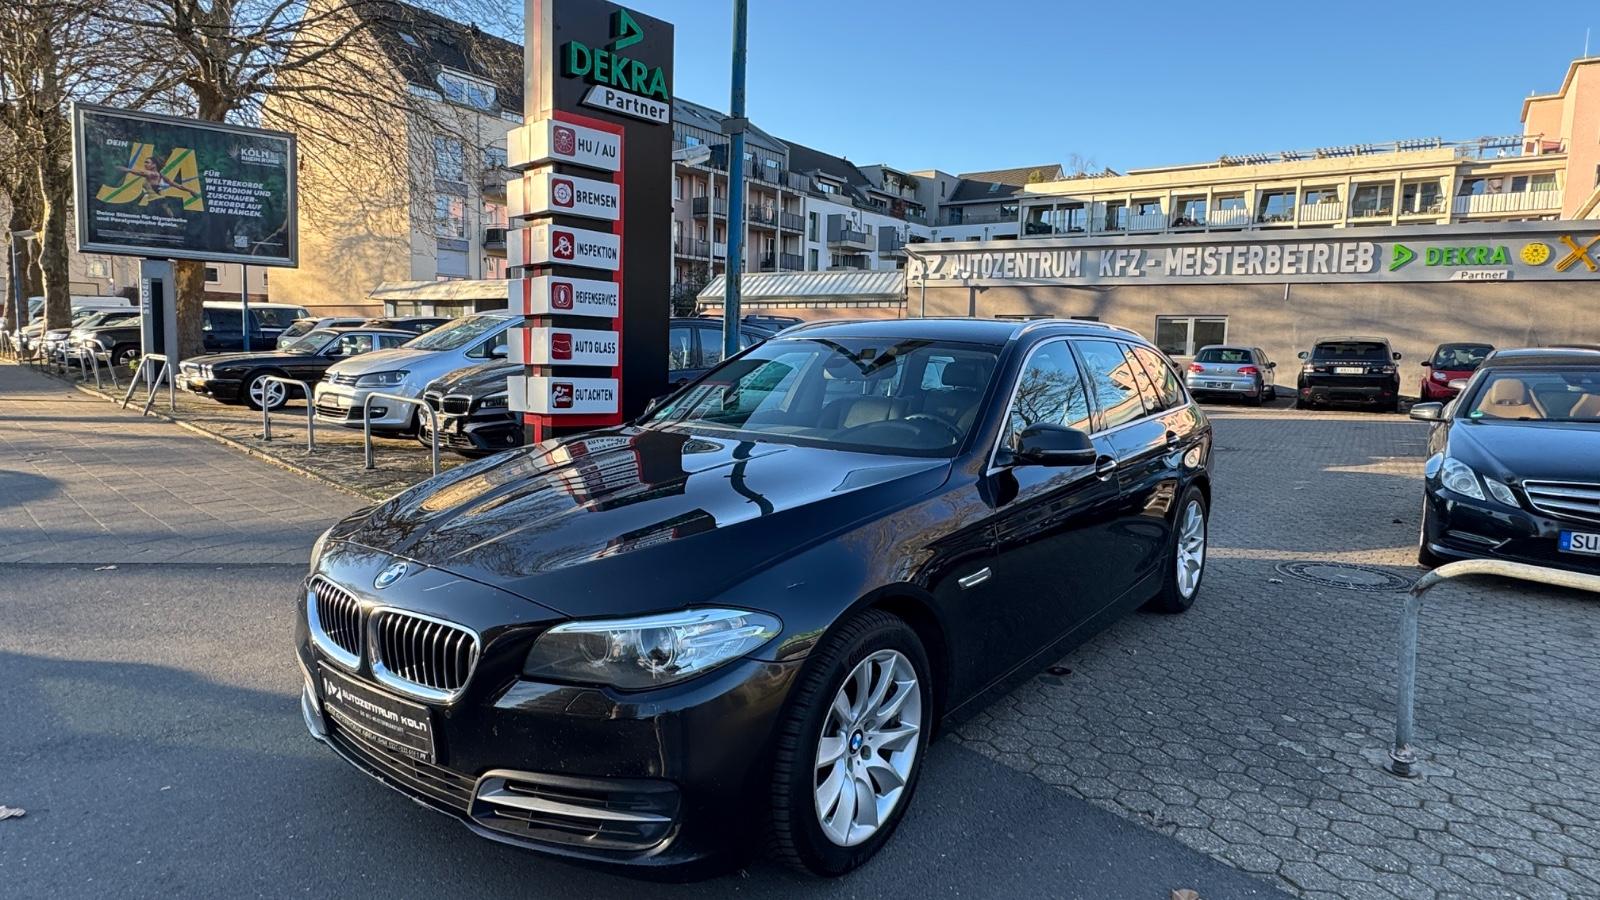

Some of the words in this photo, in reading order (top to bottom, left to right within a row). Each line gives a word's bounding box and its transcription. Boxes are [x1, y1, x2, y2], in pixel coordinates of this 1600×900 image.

[571, 40, 669, 99] DEKRA
[605, 90, 666, 120] Partner
[106, 138, 129, 147] DEIN
[577, 138, 592, 152] HU
[594, 141, 600, 156] /
[602, 143, 616, 158] AU
[241, 147, 269, 158] KÖLN
[96, 142, 204, 212] JA
[204, 169, 220, 177] FÜR
[205, 177, 264, 189] WELTREKORDE
[217, 186, 252, 195] STADION
[206, 192, 259, 202] ZUSCHAUER-
[208, 199, 246, 209] REKORDE
[576, 190, 617, 209] BREMSEN
[209, 206, 226, 214] DEN
[228, 207, 263, 217] RÄNGEN.
[576, 242, 618, 260] INSPEKTION
[1424, 246, 1508, 266] DEKRA
[949, 250, 1081, 279] AUTOZENTRUM
[1461, 270, 1505, 280] Partner
[575, 290, 617, 306] REIFENSERVICE
[575, 340, 593, 353] AUTO
[594, 342, 616, 354] GLASS
[575, 388, 613, 401] GUTACHTEN
[1572, 534, 1598, 550] SU
[342, 689, 398, 722] AUTOZENTRUM
